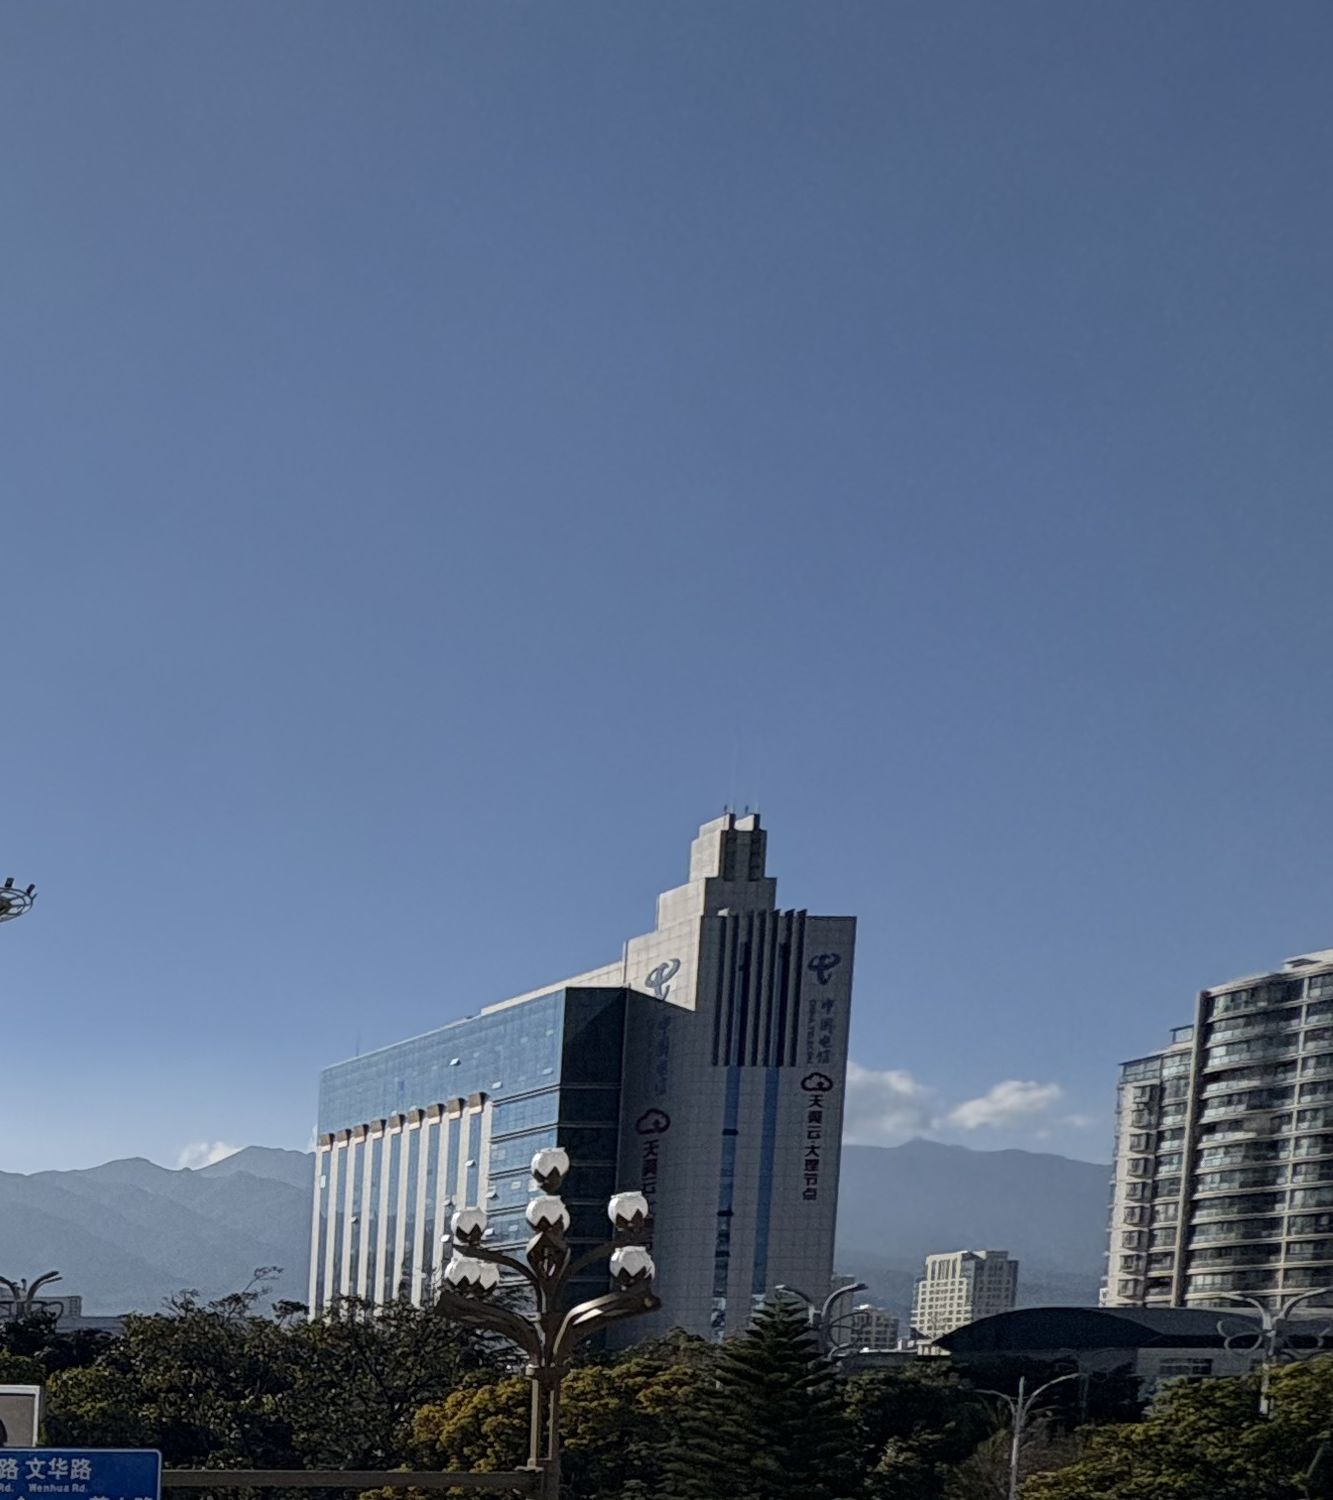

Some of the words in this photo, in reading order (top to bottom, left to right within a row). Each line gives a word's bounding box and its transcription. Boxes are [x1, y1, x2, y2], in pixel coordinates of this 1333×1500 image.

[25, 1458, 93, 1480] 文华路
[28, 1483, 69, 1493] Wenhua
[71, 1483, 89, 1493] Rd.
